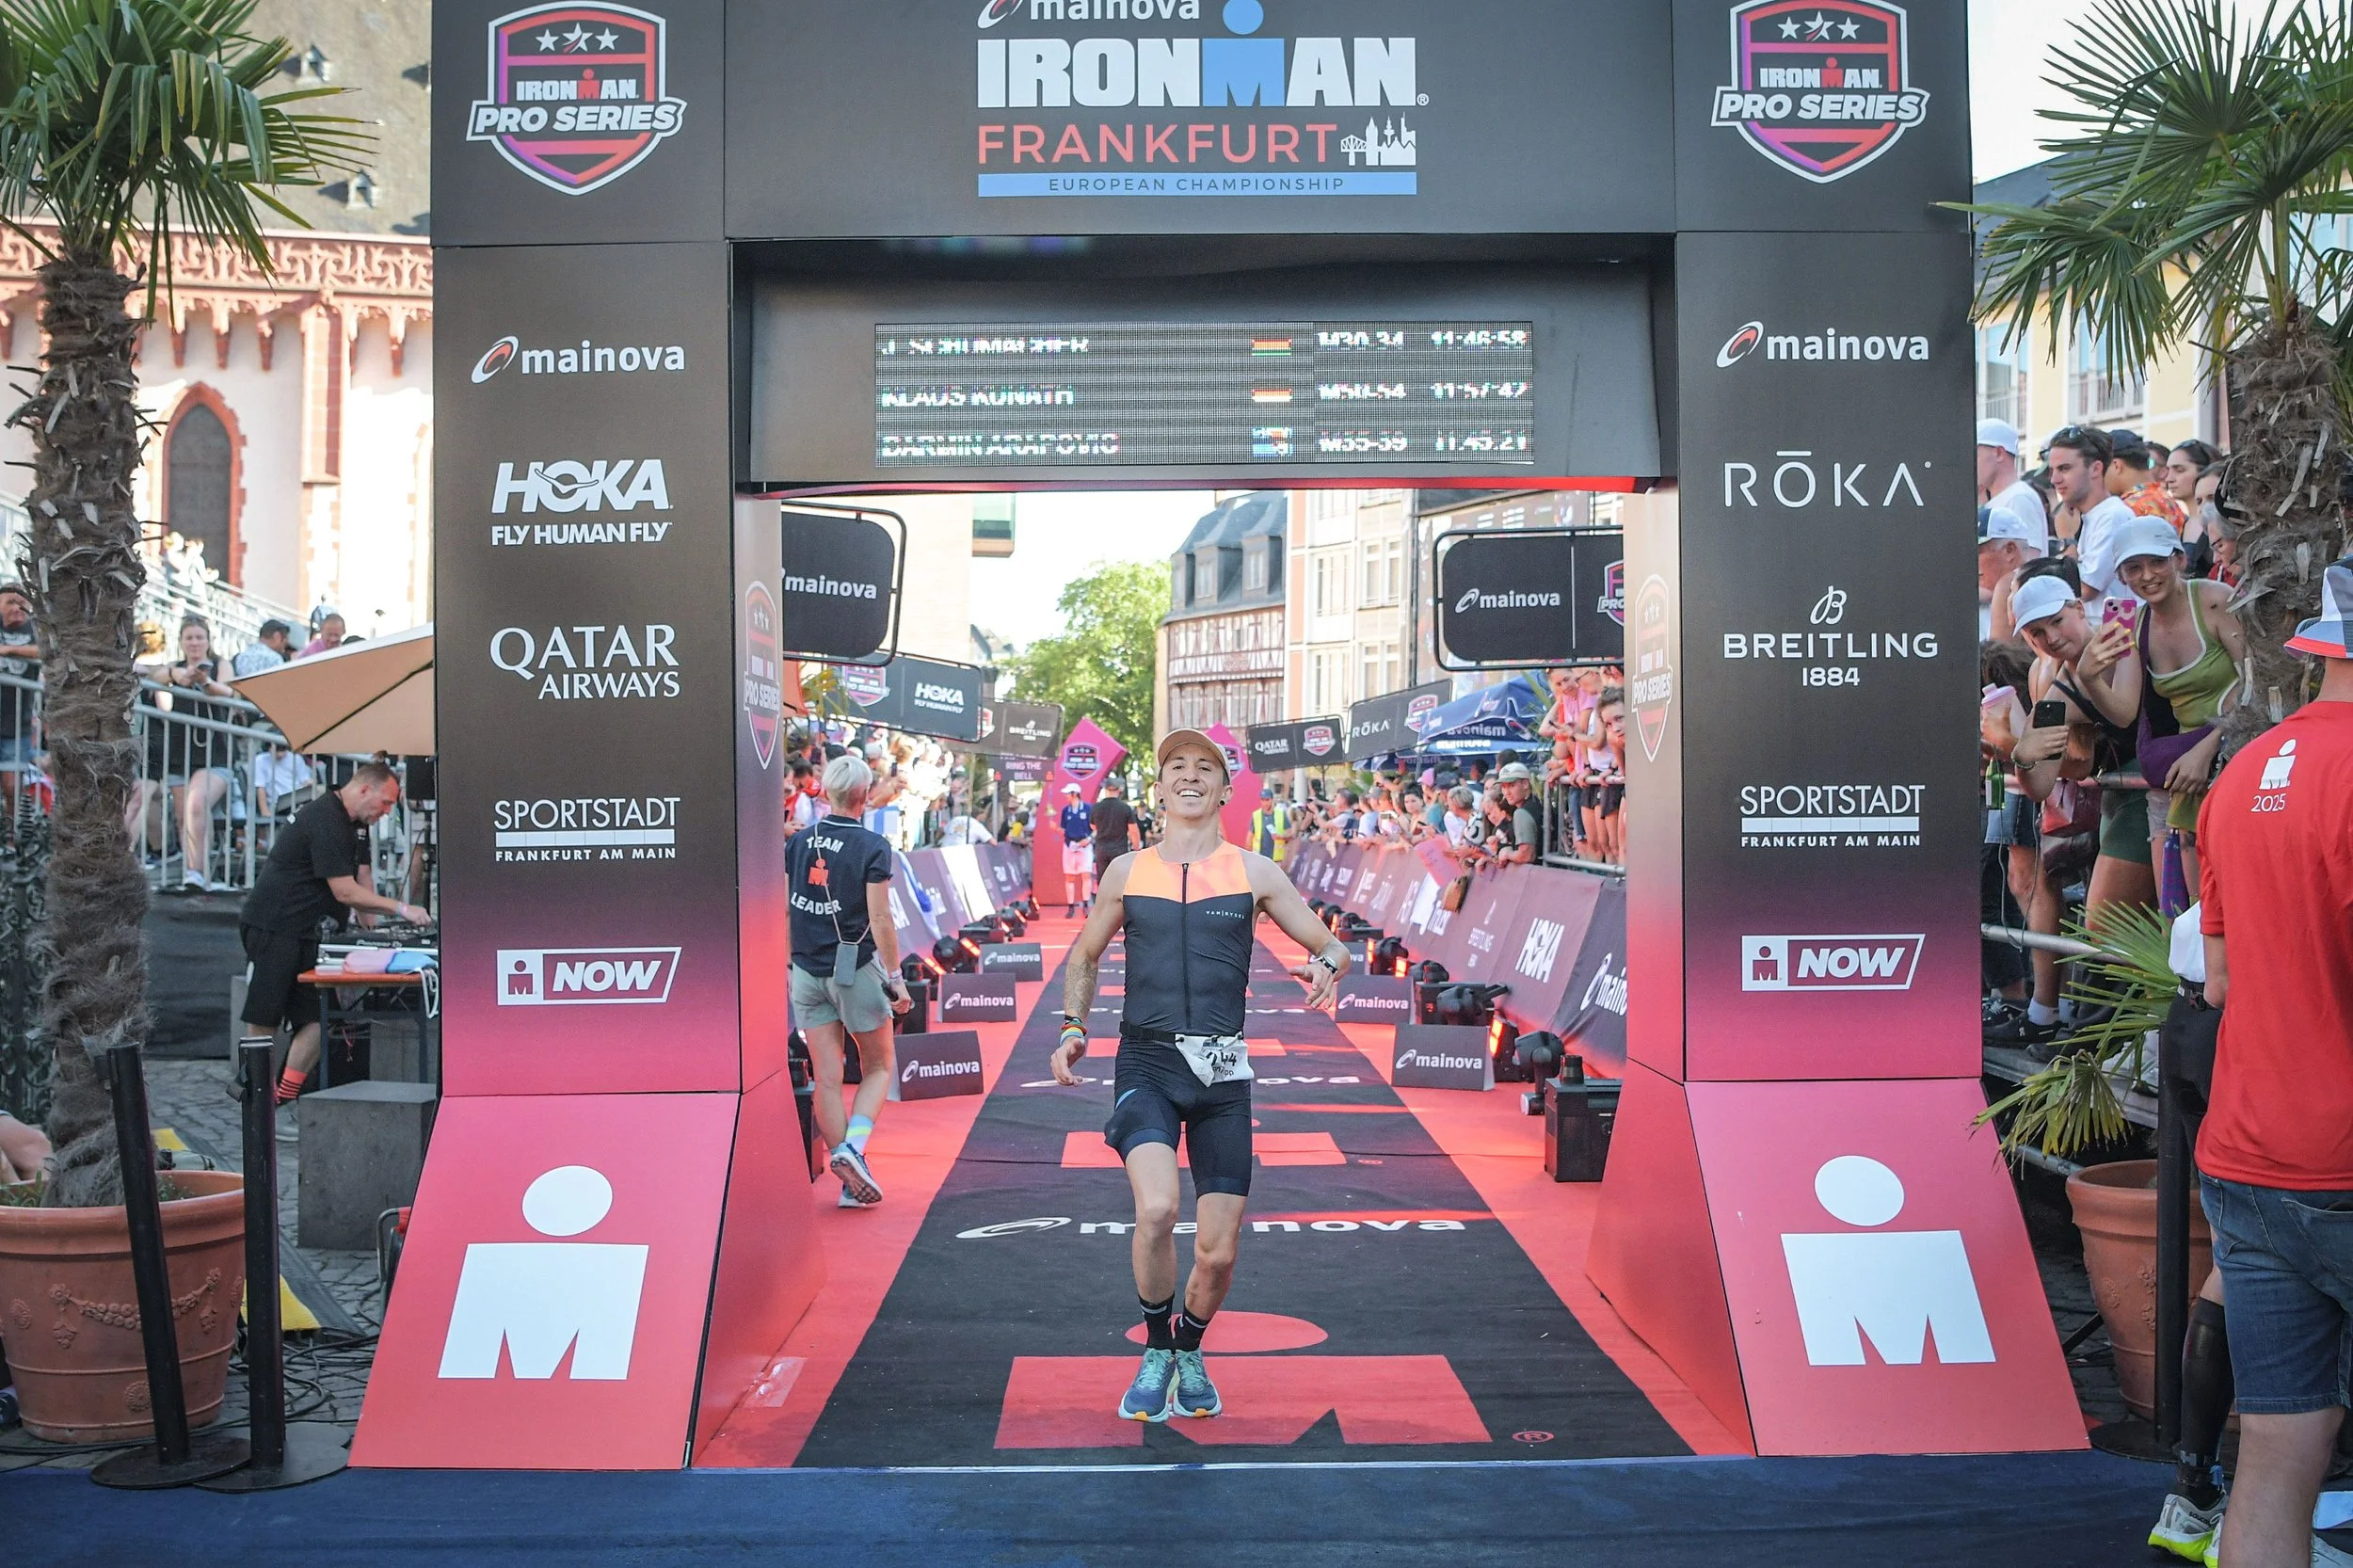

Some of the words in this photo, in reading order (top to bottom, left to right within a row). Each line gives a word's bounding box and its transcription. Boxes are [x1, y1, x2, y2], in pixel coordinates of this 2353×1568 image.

[516, 79, 637, 101] IRONMAN
[1759, 68, 1881, 89] IRONMAN
[1719, 93, 1792, 120] PRO
[1797, 94, 1922, 120] SERIES
[474, 106, 549, 134] PRO
[552, 104, 679, 132] SERIES
[978, 123, 1337, 164] FRANKFURT
[1048, 178, 1166, 192] EUROPEAN
[1176, 177, 1344, 191] CHAMPIONSHIP
[1767, 328, 1929, 360] mainova
[520, 340, 685, 374] mainova
[491, 458, 673, 513] HOKA
[491, 524, 530, 546] FLY
[534, 522, 626, 545] HUMAN
[784, 574, 877, 600] mainova
[1480, 590, 1561, 609] mainova
[489, 624, 680, 680] QATAR
[1723, 632, 1939, 659] BREITLING
[537, 670, 680, 700] AIRWAYS
[1633, 677, 1647, 705] PRO
[1647, 671, 1672, 701] SERIES
[1801, 666, 1861, 687] 1884
[744, 680, 759, 706] PRO
[914, 682, 965, 705] HOKA
[1255, 738, 1289, 752] QATAR
[1005, 761, 1025, 770] RING
[1026, 760, 1042, 771] THE
[1014, 772, 1033, 780] BELL
[1739, 785, 1926, 815] SPORTSTADT
[2250, 792, 2286, 813] 2025
[493, 797, 680, 829] SPORTSTADT
[806, 836, 844, 853] TEAM
[1741, 836, 1837, 847] FRANKFURT
[1845, 836, 1868, 846] AM
[1877, 835, 1920, 846] MAIN
[495, 849, 592, 861] FRANKFURT
[600, 848, 624, 860] AM
[632, 847, 676, 859] MAIN
[790, 891, 842, 916] LEADER
[997, 952, 1041, 964] mainova
[1514, 918, 1565, 984] HOKA
[1797, 947, 1906, 979] NOW
[552, 960, 663, 992] NOW
[960, 992, 1015, 1007] mainova
[1353, 996, 1409, 1010] mainova
[1594, 967, 1627, 1016] maino
[919, 1059, 981, 1079] mainova
[1416, 1054, 1483, 1070] mainova
[1079, 1219, 1466, 1235] manova
